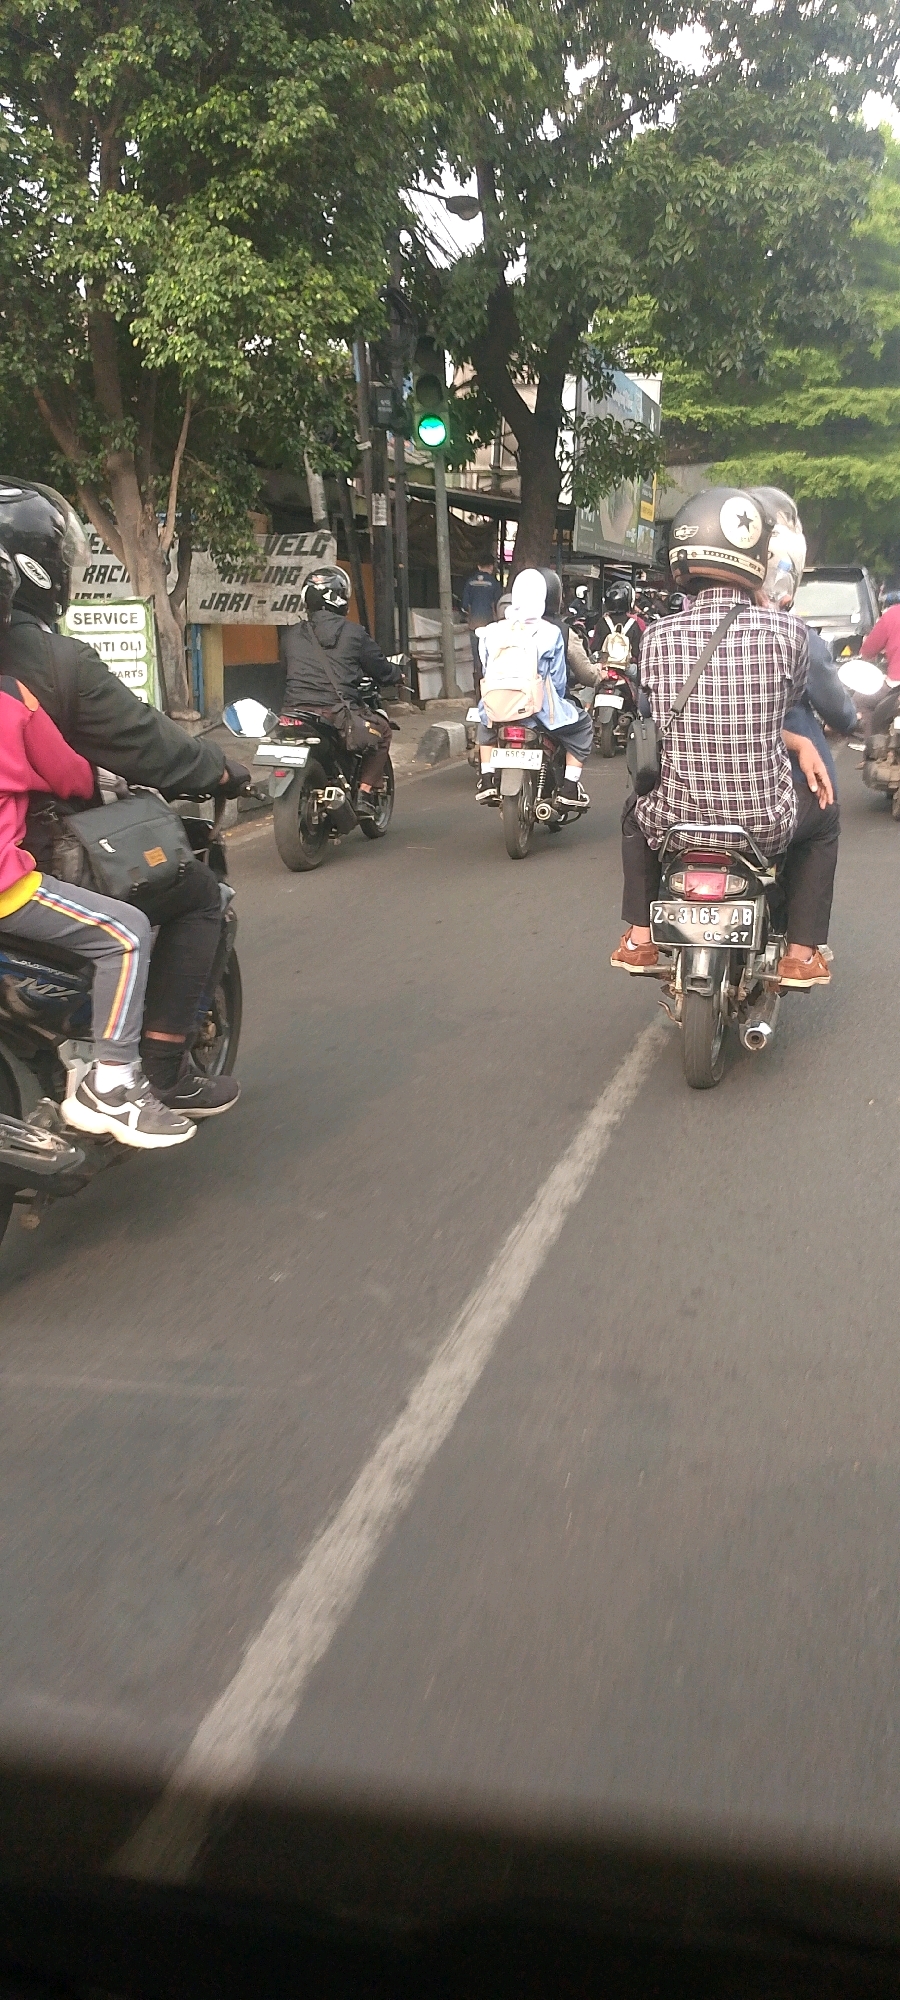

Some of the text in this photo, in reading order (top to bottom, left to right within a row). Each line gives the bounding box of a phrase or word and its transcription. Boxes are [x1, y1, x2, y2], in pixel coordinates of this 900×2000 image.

[200, 592, 252, 613] JARI
[73, 612, 138, 625] SERVICE
[120, 640, 141, 652] OLI
[654, 906, 753, 926] Z 3165 AB
